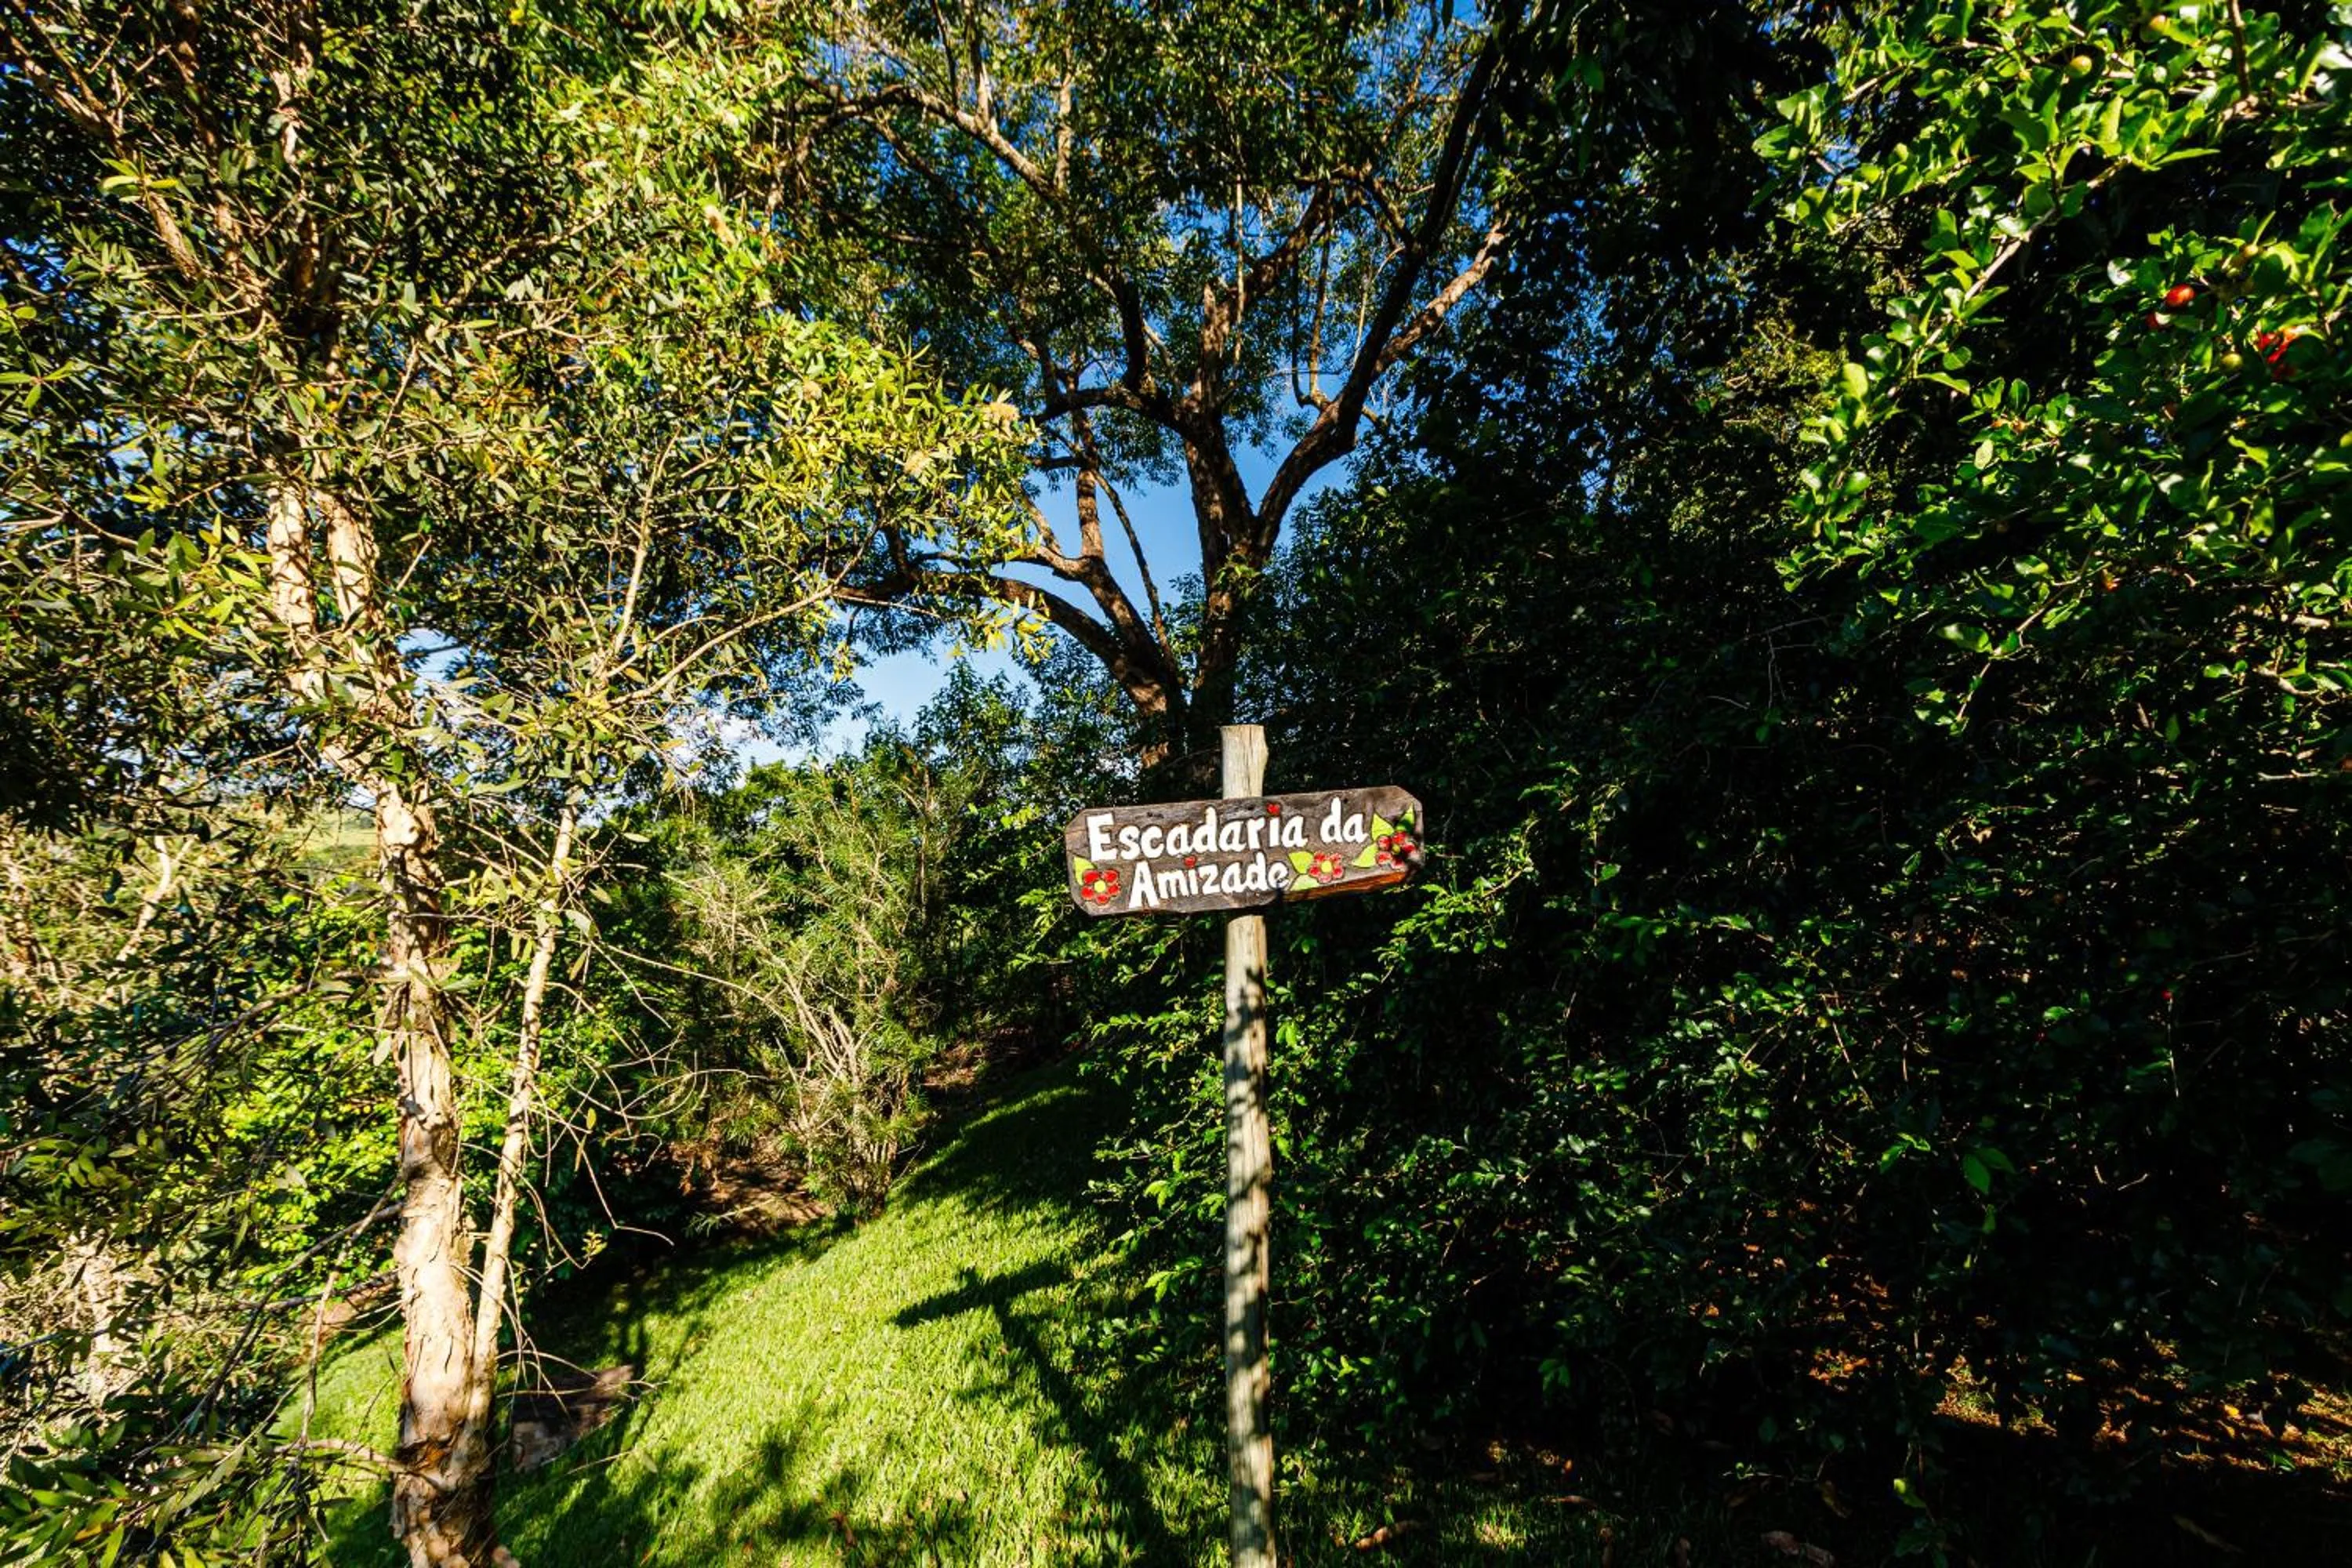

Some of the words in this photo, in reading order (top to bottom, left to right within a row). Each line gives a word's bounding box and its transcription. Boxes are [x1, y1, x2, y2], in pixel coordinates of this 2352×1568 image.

[1087, 804, 1308, 862] Escadaria
[1320, 797, 1368, 844] da
[1129, 852, 1290, 909] Amizade
